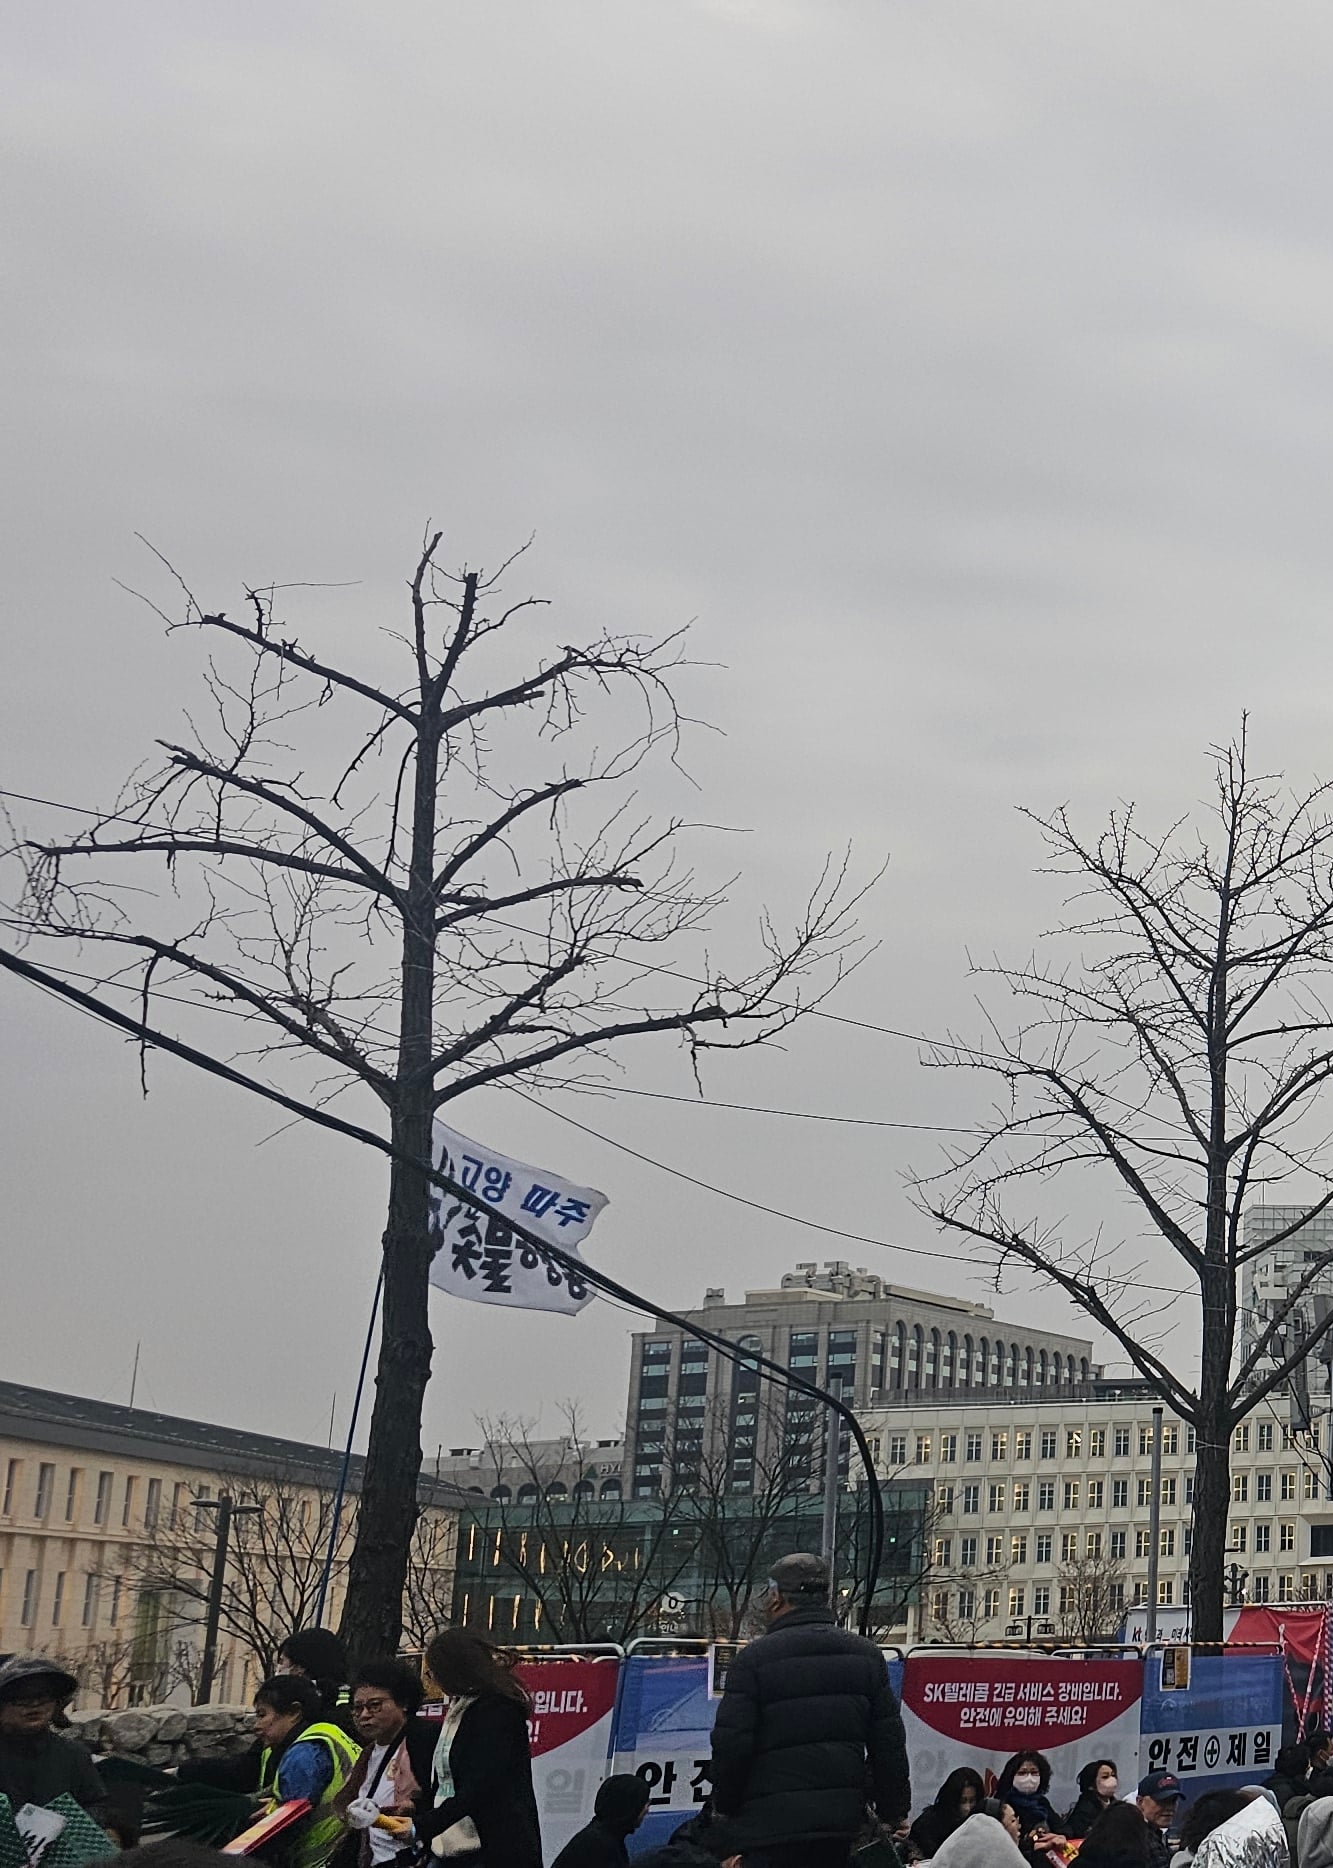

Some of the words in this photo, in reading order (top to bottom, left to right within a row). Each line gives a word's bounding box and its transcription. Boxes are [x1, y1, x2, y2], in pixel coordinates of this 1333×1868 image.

[462, 1154, 513, 1203] 고양
[520, 1184, 591, 1227] 파주
[924, 1682, 990, 1703] SK텔레콤
[993, 1683, 1015, 1702] 긴급
[1017, 1682, 1055, 1702] 서비스
[1058, 1681, 1123, 1701] 장비입니다.
[959, 1706, 1003, 1728] 안전에
[1004, 1706, 1042, 1727] 유의해
[1044, 1706, 1088, 1725] 주세요!
